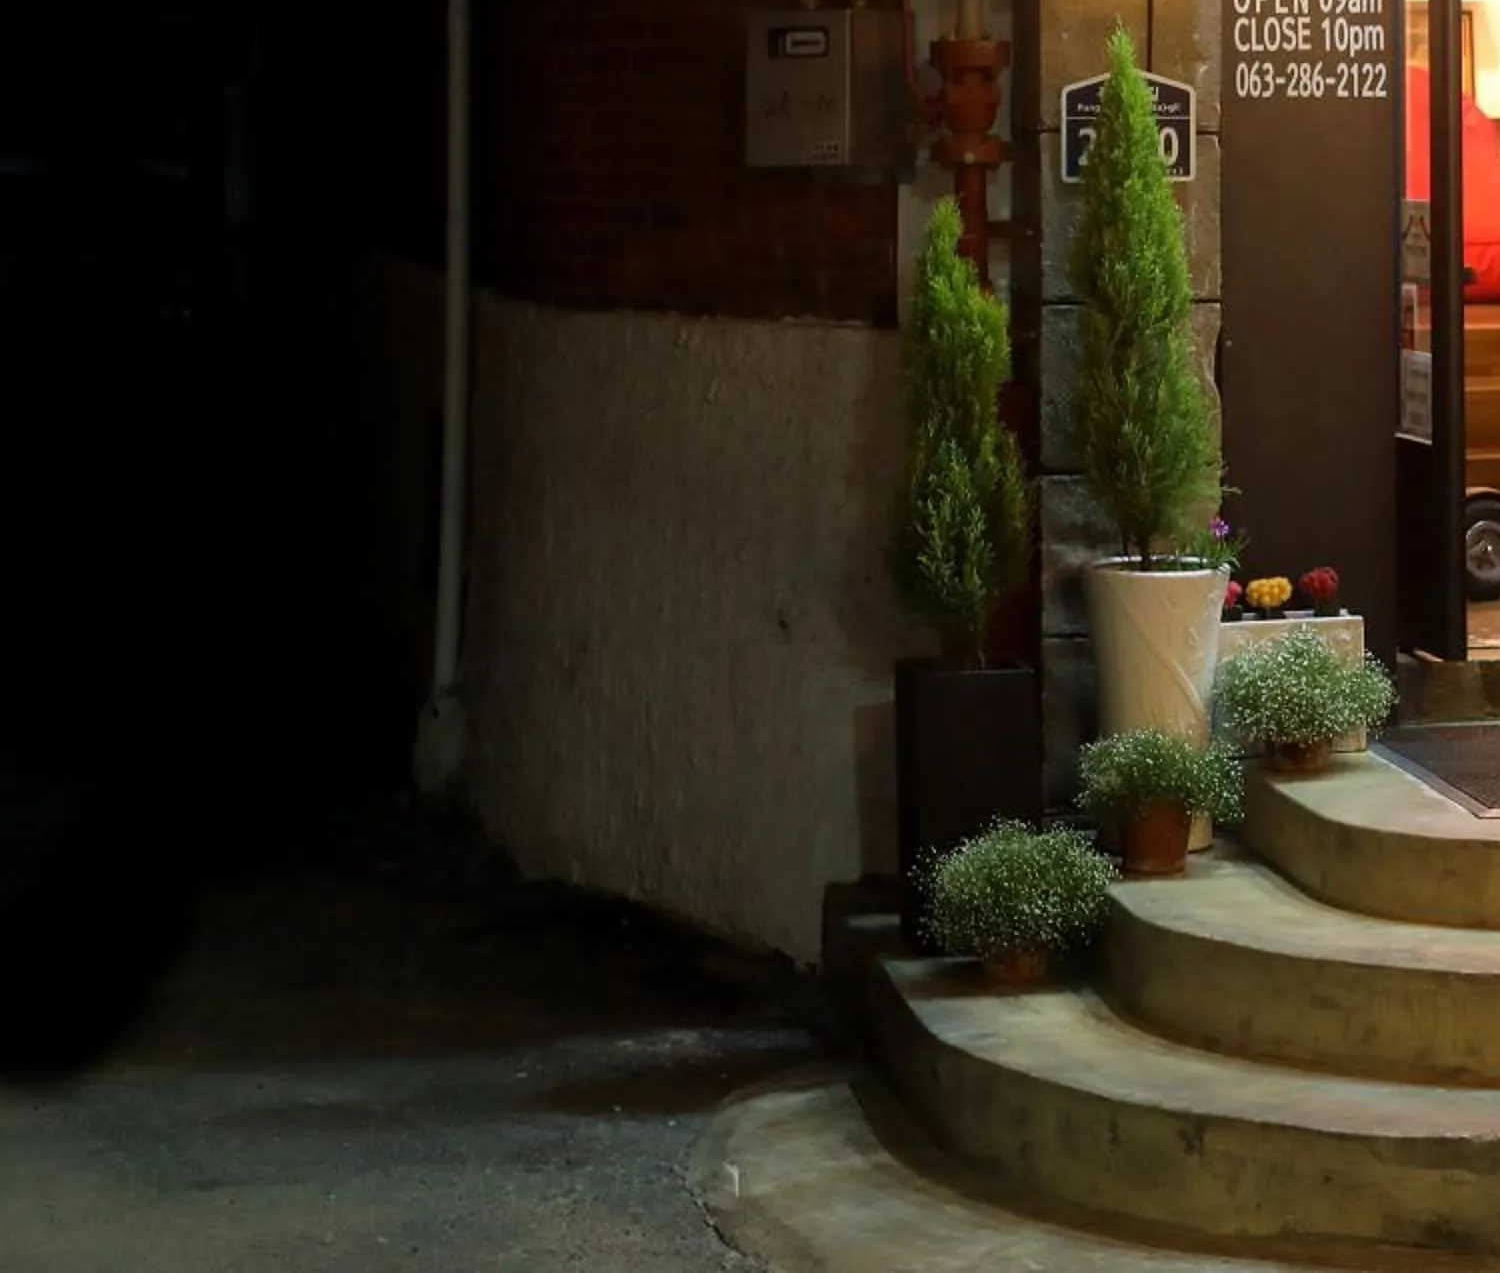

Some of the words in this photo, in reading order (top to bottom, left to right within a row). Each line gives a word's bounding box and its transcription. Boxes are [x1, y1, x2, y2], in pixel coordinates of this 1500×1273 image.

[1234, 17, 1312, 52] CLOSE
[1323, 19, 1386, 58] 10pm
[1236, 61, 1388, 98] 063-286-2122
